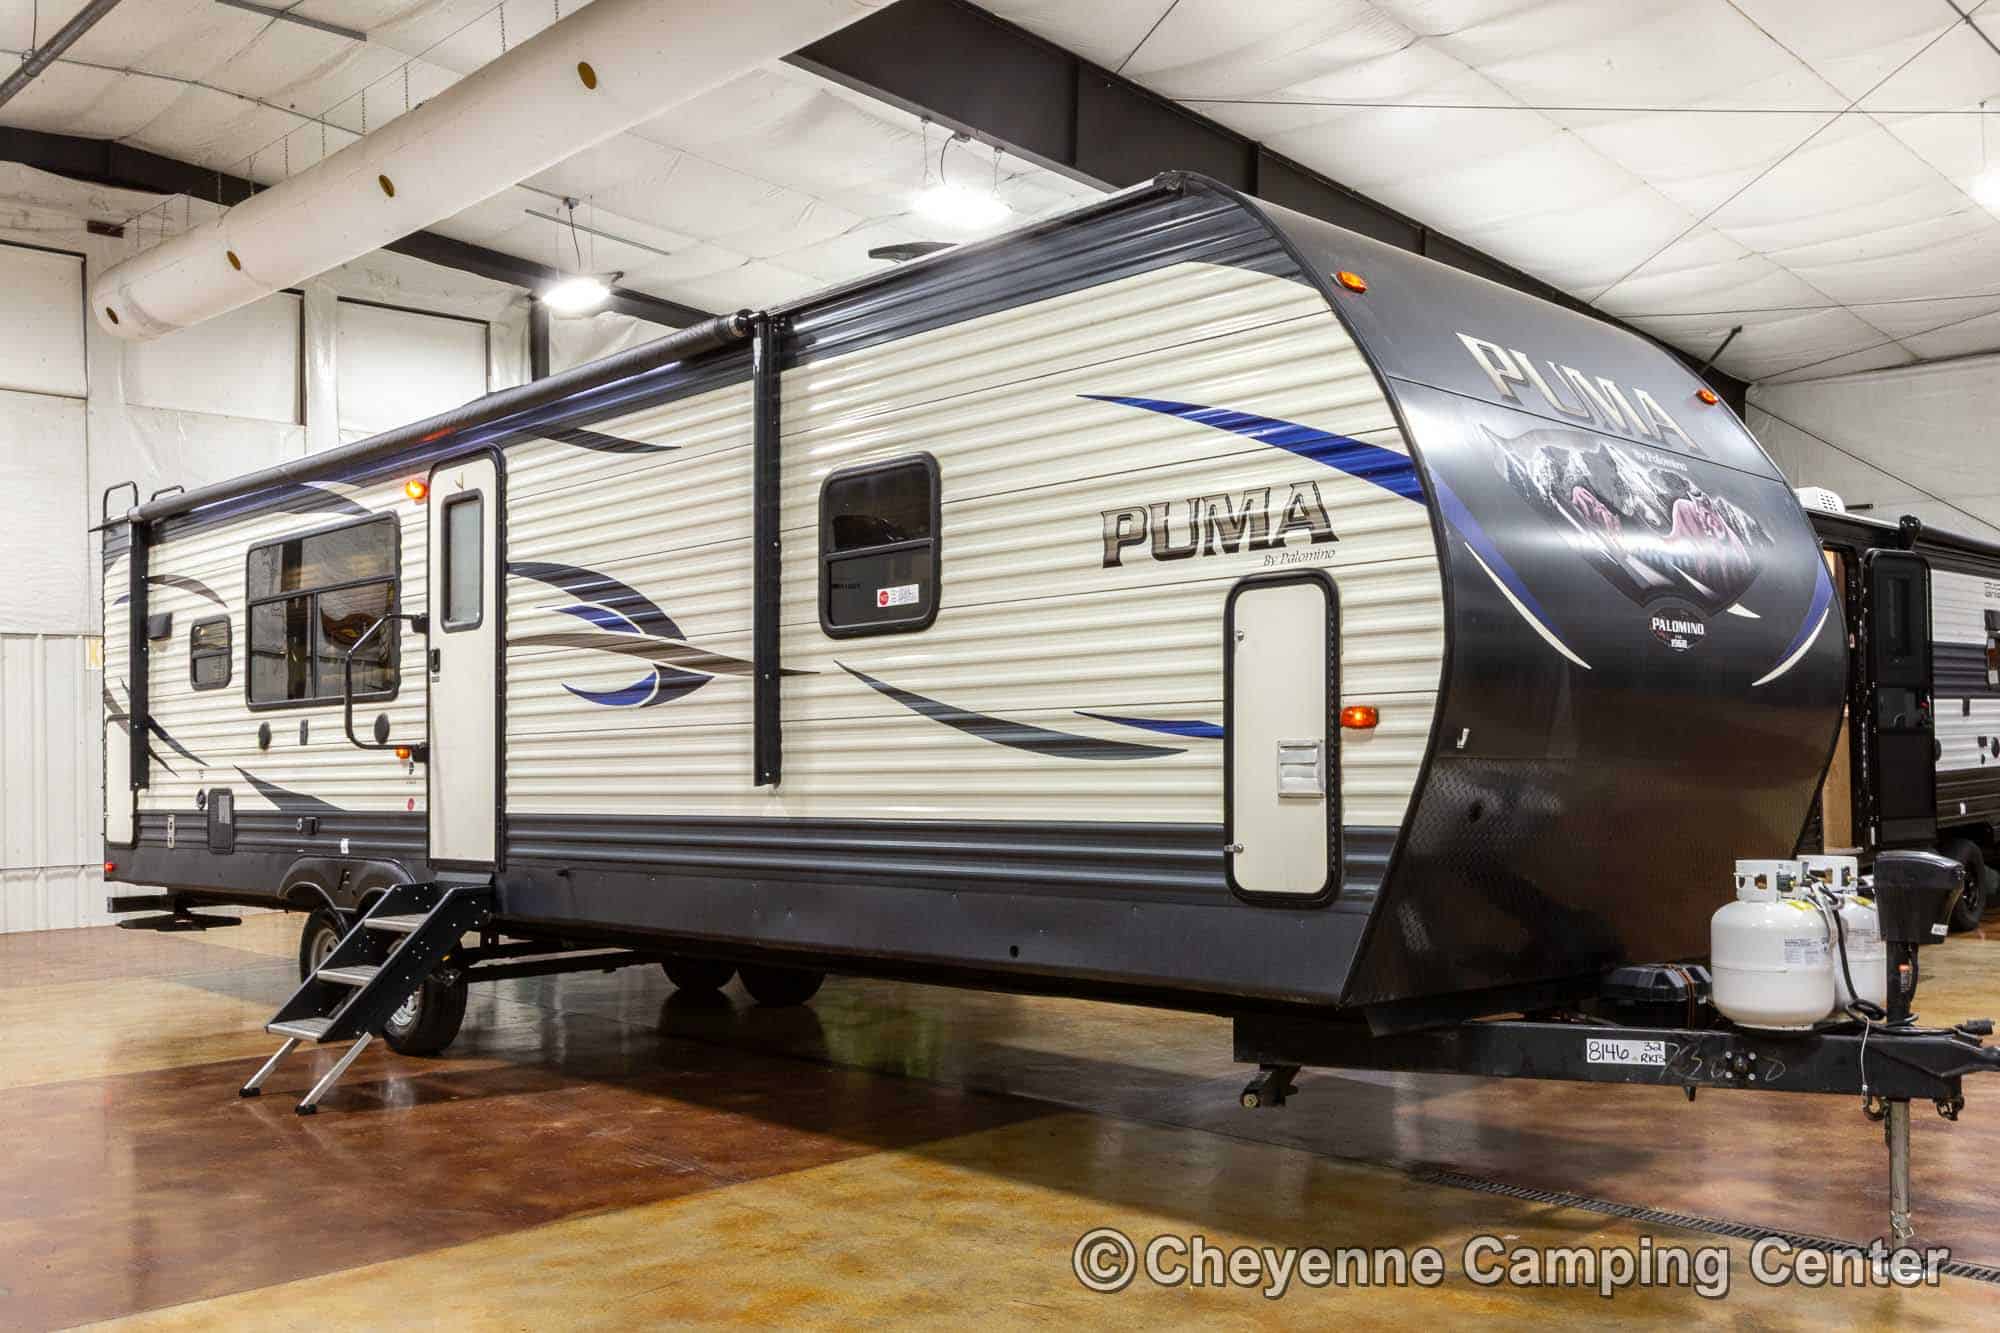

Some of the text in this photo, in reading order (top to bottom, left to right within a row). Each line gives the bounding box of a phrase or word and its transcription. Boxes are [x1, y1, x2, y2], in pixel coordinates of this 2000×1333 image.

[1456, 332, 1700, 450] PUMA
[1101, 480, 1339, 568] PUMA
[1263, 549, 1336, 567] By Palomino
[1652, 616, 1705, 636] PALOMINO
[1588, 1041, 1630, 1062] 8146
